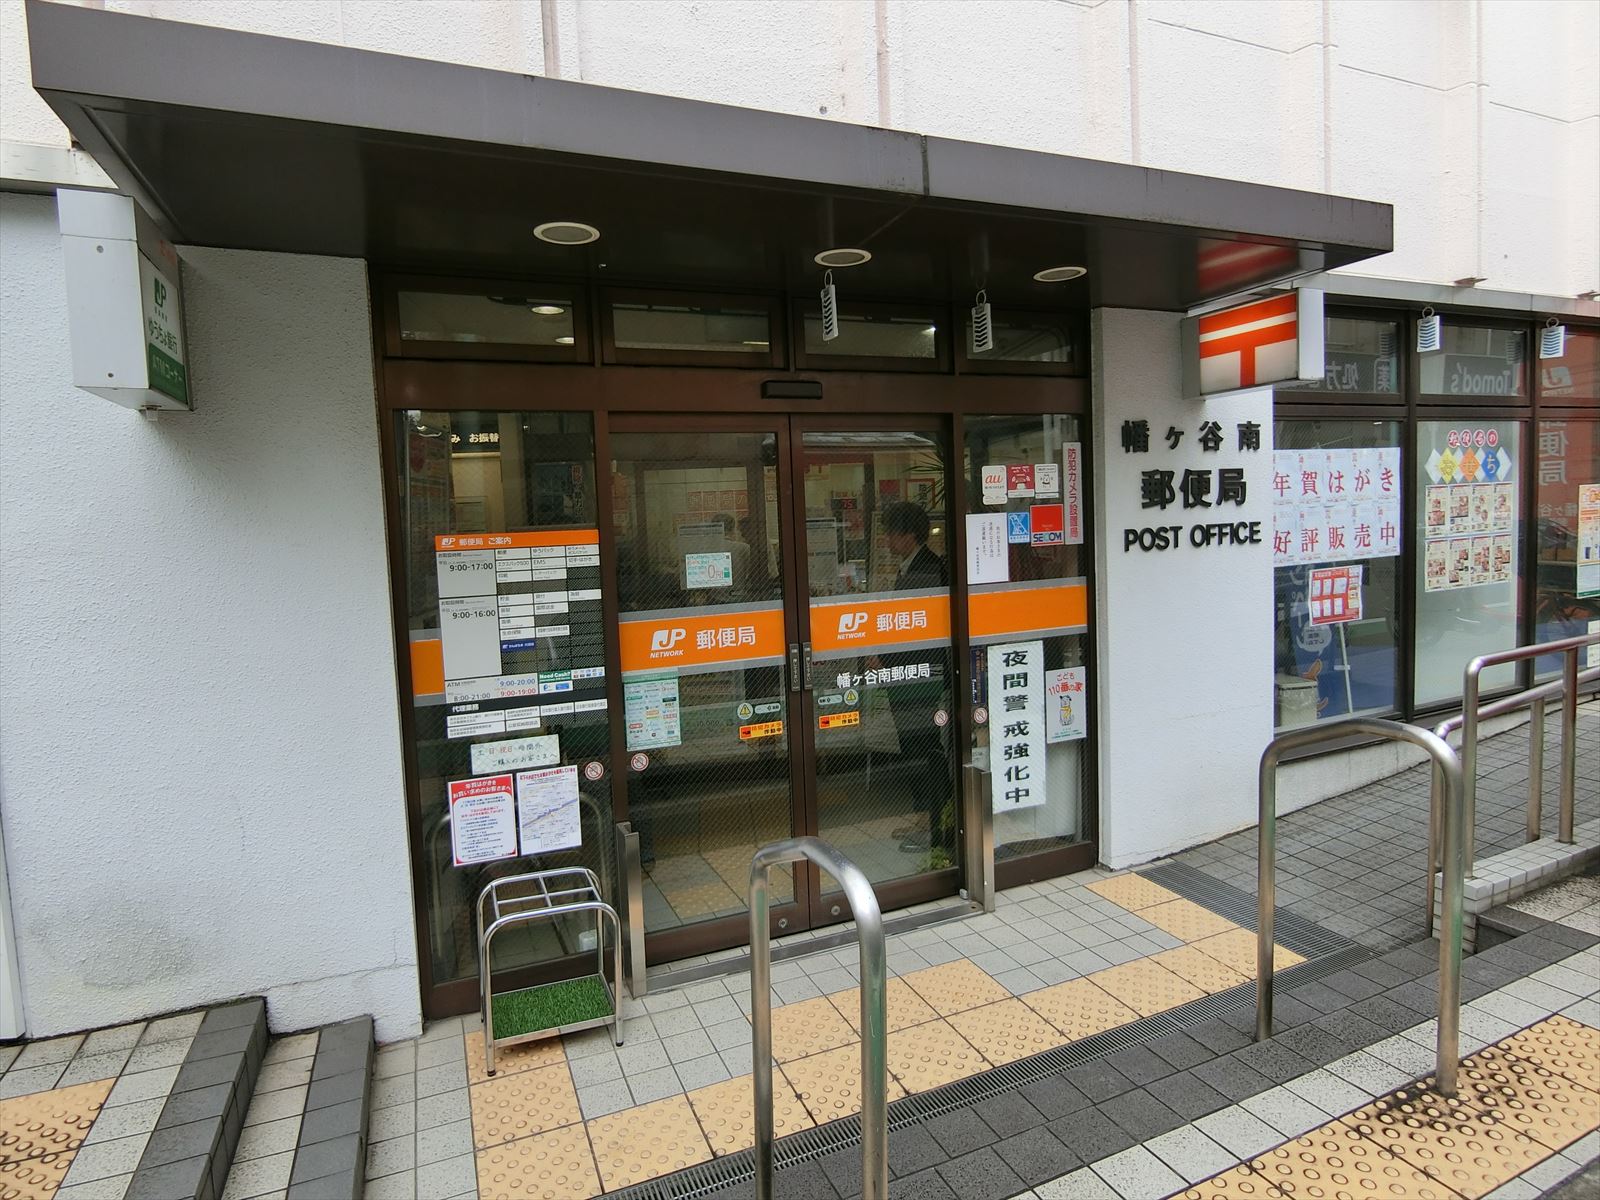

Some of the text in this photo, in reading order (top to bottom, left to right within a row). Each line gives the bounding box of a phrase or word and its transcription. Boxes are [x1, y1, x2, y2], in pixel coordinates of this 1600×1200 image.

[1121, 420, 1261, 453] 幡ヶ谷南
[985, 474, 1003, 484] au
[1273, 467, 1394, 497] 年賀はがき
[1141, 468, 1247, 510] 郵便局
[488, 536, 512, 545] ご案内
[1033, 531, 1062, 543] SECOM
[1124, 521, 1262, 552] POST OFFICE
[1273, 521, 1395, 556] 好評販売中
[449, 562, 493, 572] 9:00-17:00
[452, 609, 496, 620] 9:00-16:00
[838, 610, 927, 633] JP 郵便局
[651, 625, 756, 651] JP 郵便局
[837, 631, 866, 640] NETWORK
[649, 649, 684, 659] NETWORK
[836, 662, 931, 689] 幡ヶ谷南郵便局
[1056, 671, 1075, 682] こども
[500, 678, 536, 687] 9:00-20:00
[500, 688, 537, 697] 9:00-19:00
[1048, 681, 1083, 696] 110番の家
[454, 692, 491, 702] 8:00-21:00
[1002, 650, 1030, 803] 夜間警戒強化中
[465, 779, 497, 790] 年賀はがきを
